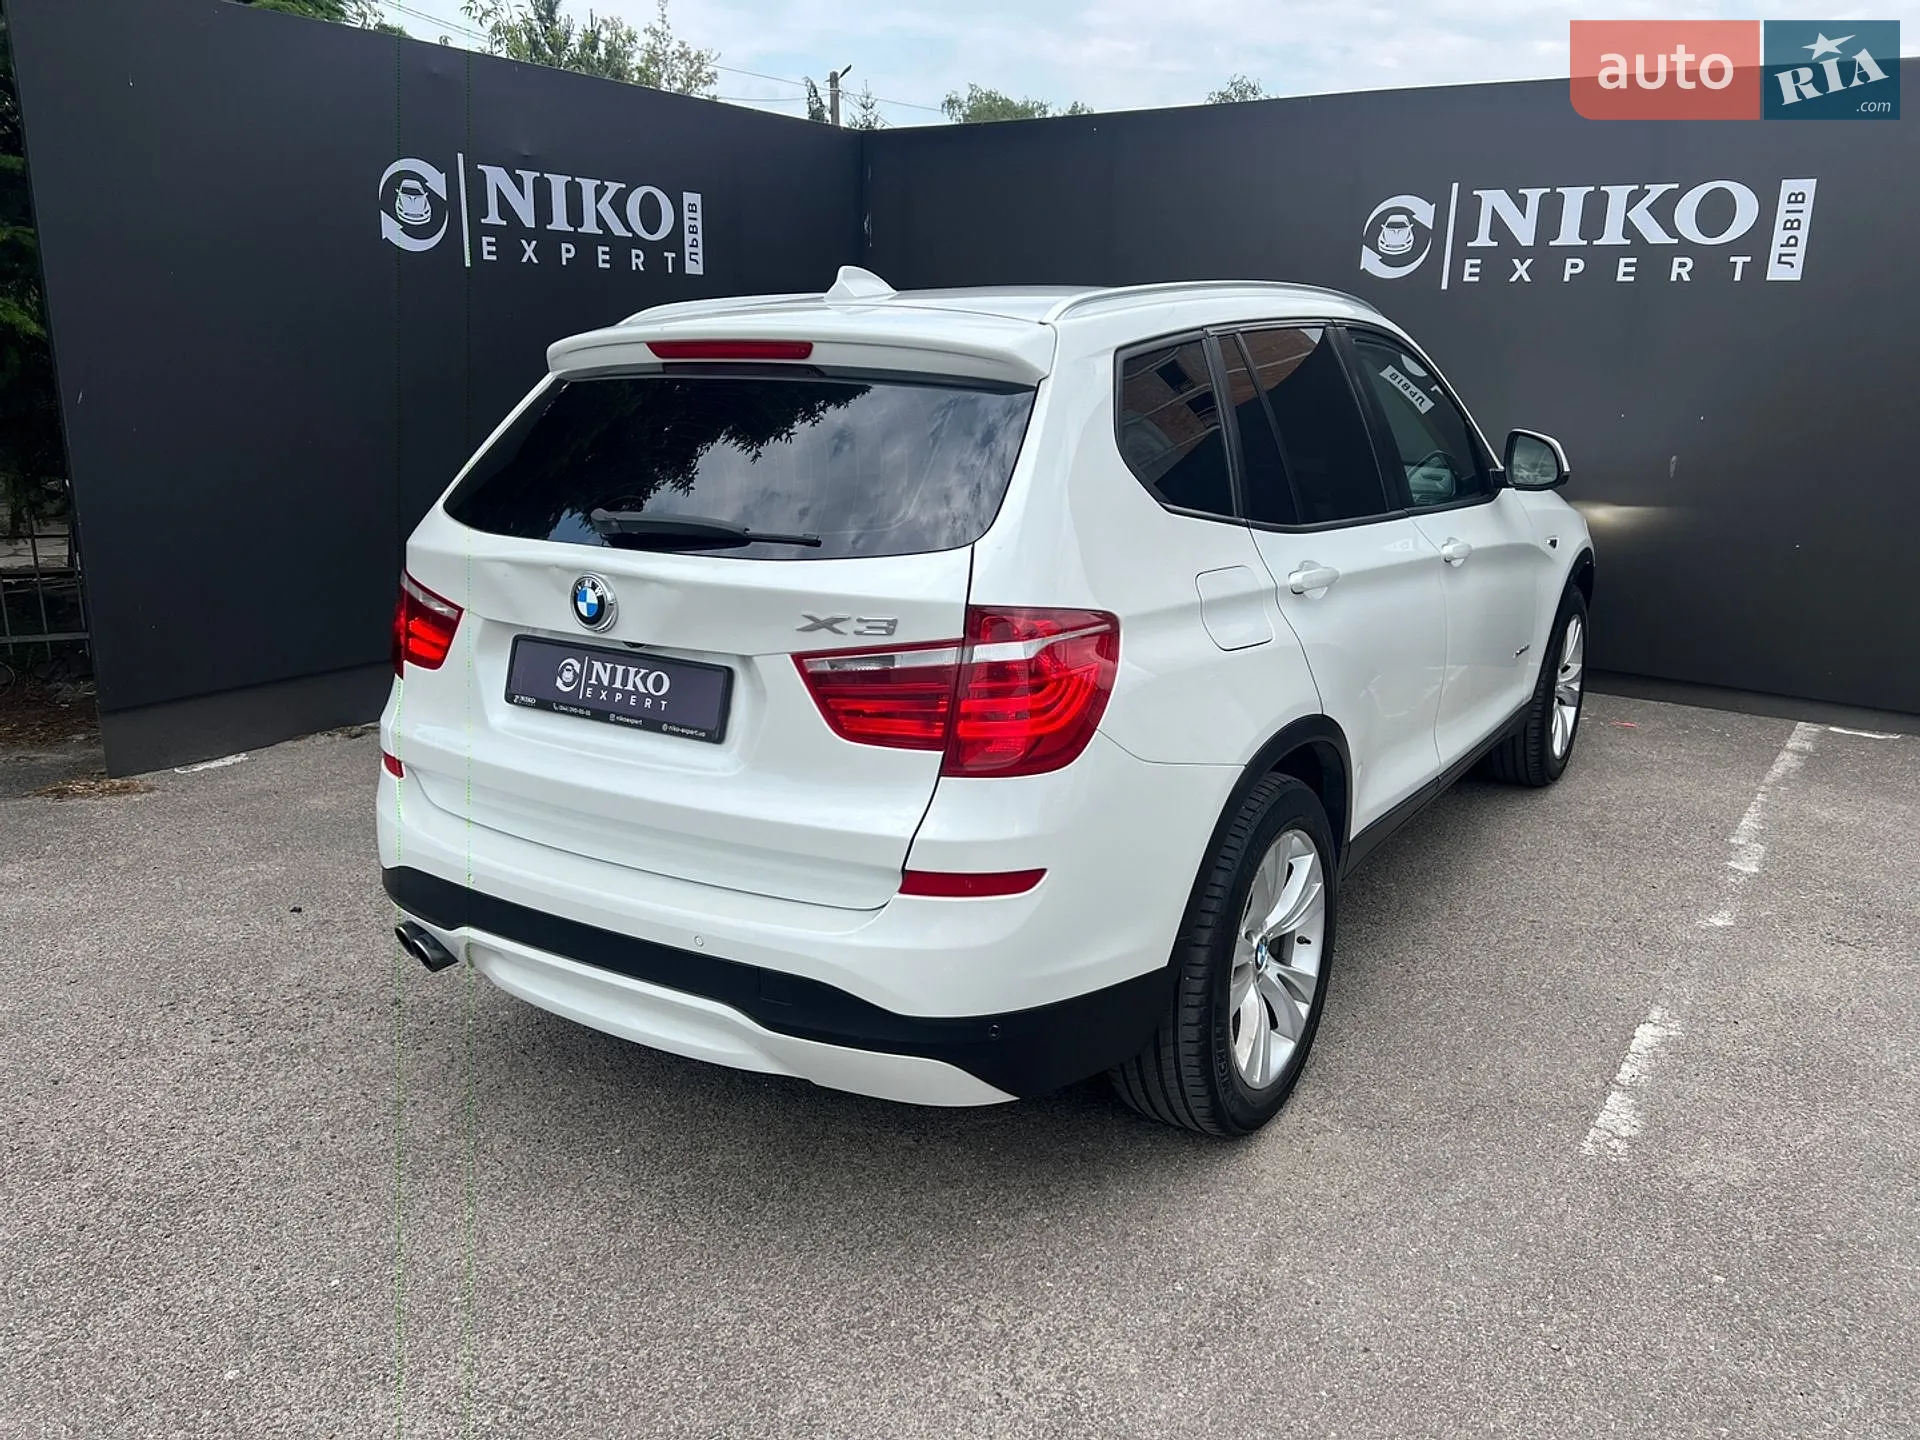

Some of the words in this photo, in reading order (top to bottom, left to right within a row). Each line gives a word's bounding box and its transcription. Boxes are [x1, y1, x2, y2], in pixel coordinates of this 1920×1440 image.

[476, 163, 675, 242] NIKO
[1466, 179, 1760, 248] NIKO
[688, 202, 700, 266] ЛЬВІВ
[1776, 190, 1808, 269] ЛЬВІВ
[481, 236, 677, 273] EXPERT
[1462, 255, 1752, 283] EXPERT
[795, 612, 898, 636] X3
[588, 660, 671, 696] NIKO
[585, 687, 669, 712] EXPERT
